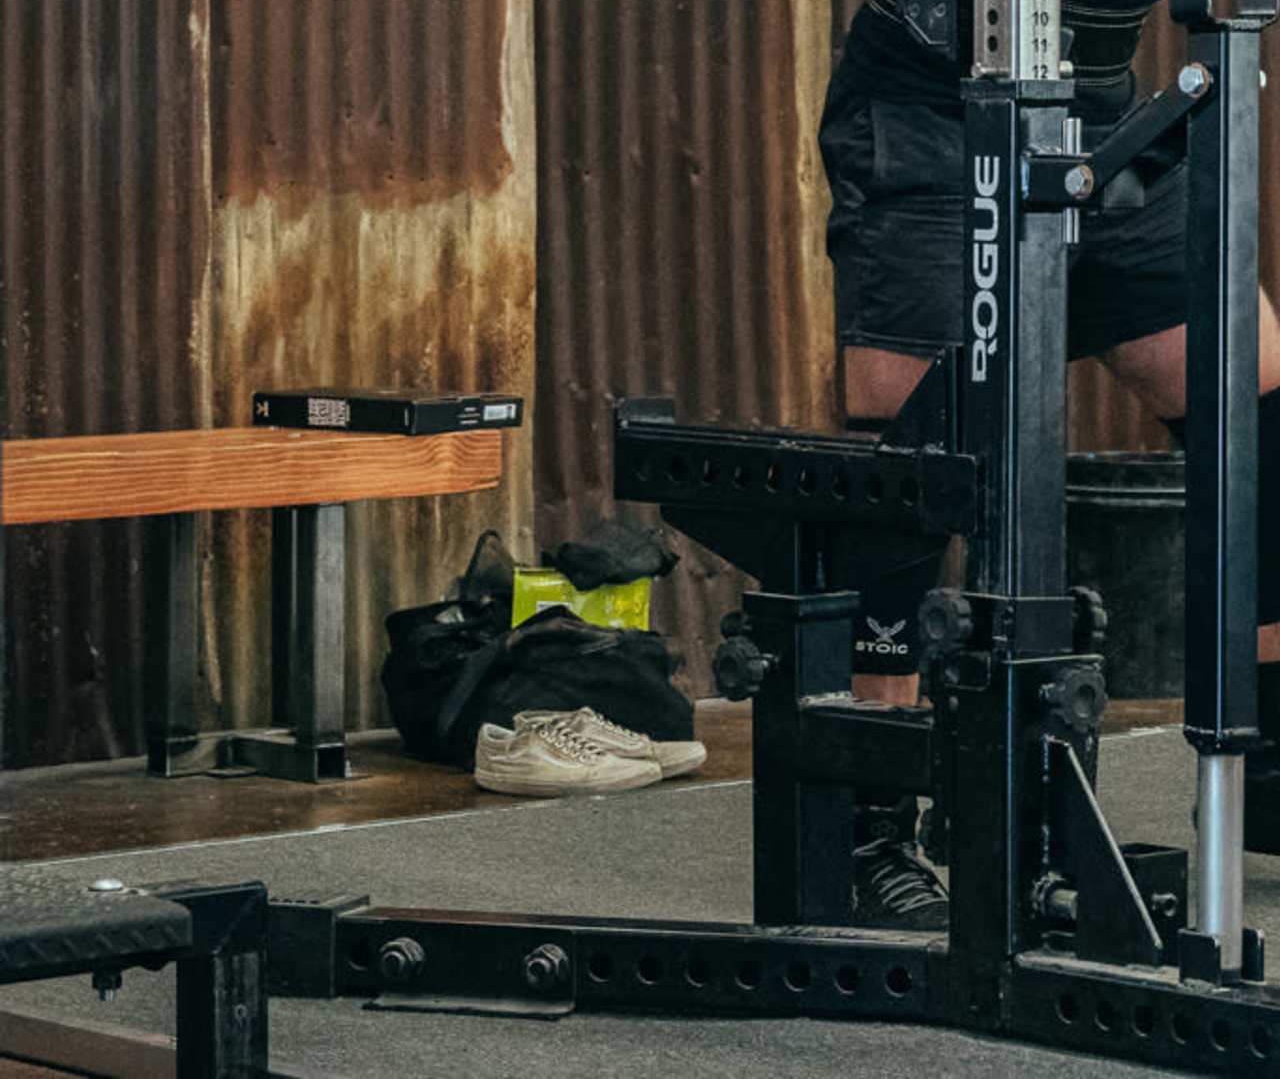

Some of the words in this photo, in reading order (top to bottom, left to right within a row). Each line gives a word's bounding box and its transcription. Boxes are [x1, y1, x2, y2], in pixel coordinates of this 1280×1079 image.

[1033, 11, 1049, 26] 10
[1033, 37, 1048, 52] 11
[1033, 64, 1049, 79] 12
[971, 156, 1000, 382] ROGUE
[854, 640, 909, 655] STOIC
